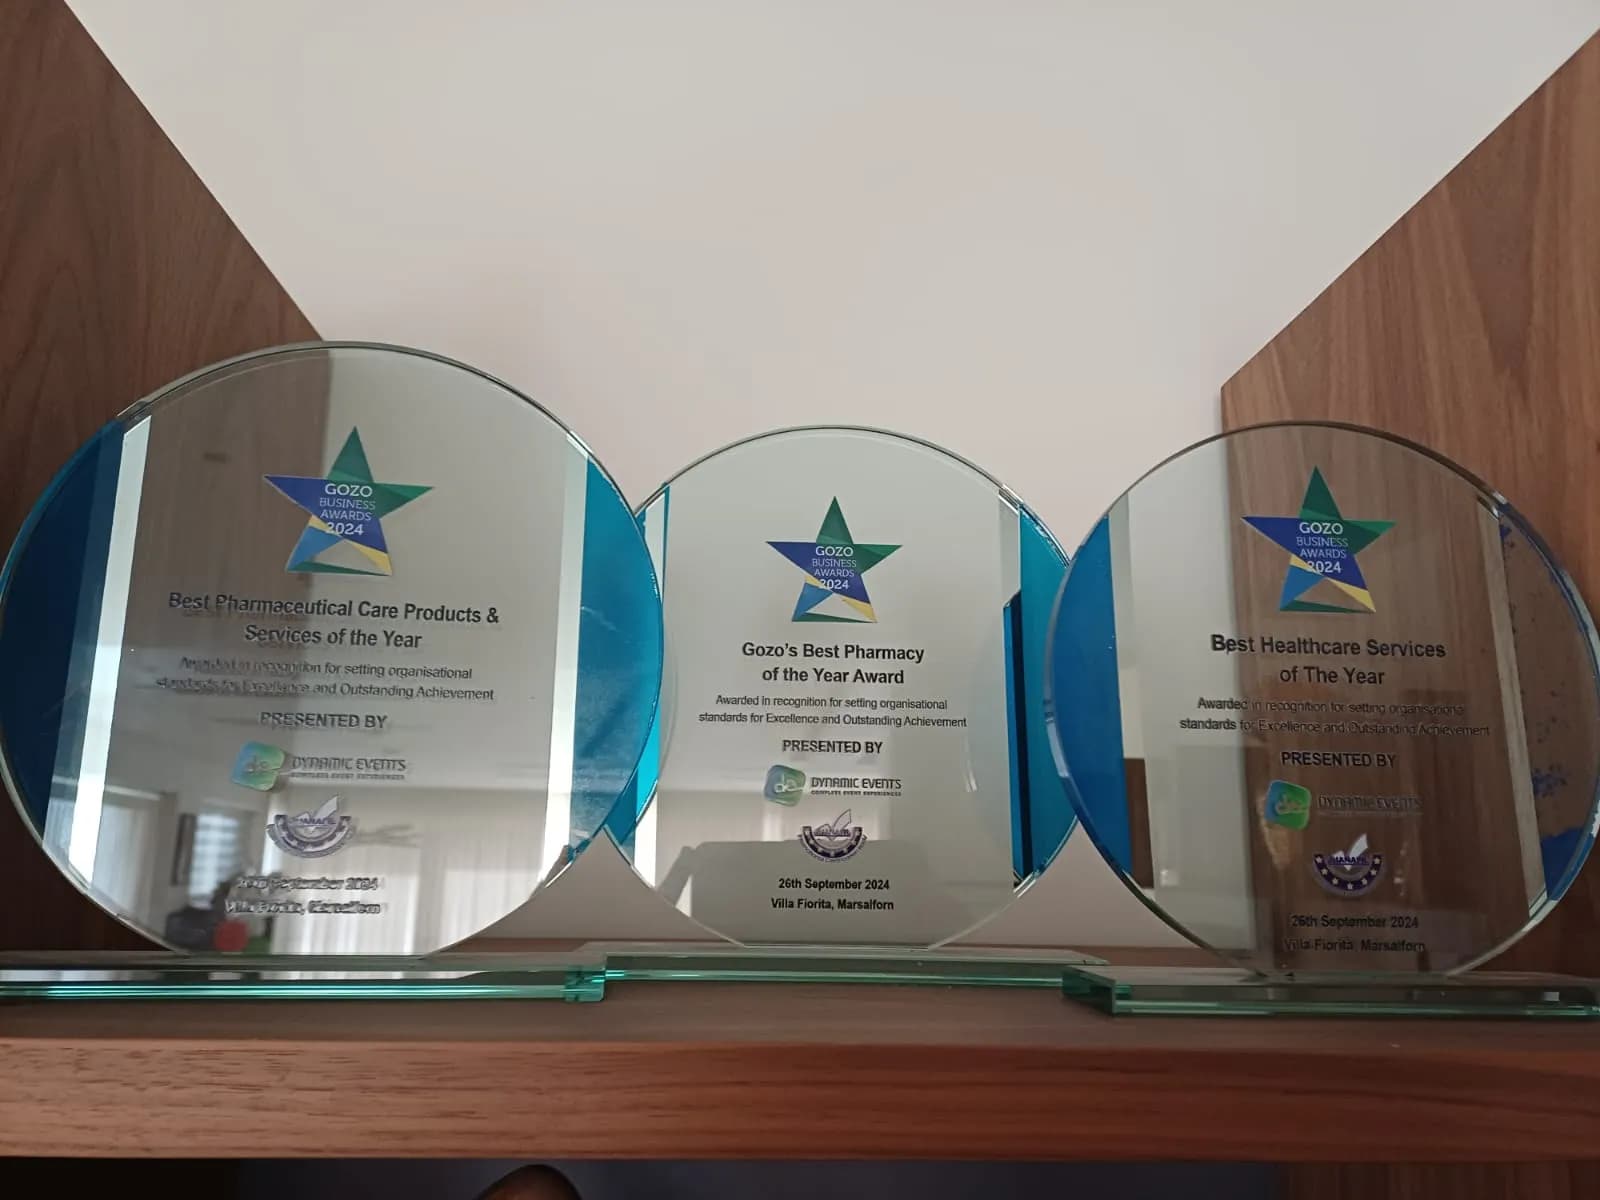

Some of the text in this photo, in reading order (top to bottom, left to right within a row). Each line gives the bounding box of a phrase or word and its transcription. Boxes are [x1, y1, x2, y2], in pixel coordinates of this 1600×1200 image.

[324, 482, 373, 498] GOZO
[319, 497, 376, 511] BUSINESS
[320, 509, 372, 521] AWARDS
[325, 522, 364, 536] 2024
[1299, 522, 1344, 535] GOZO
[1296, 536, 1349, 548] BUSINESS
[815, 546, 854, 557] GOZO
[1300, 548, 1347, 559] AWARDS
[811, 558, 857, 568] BUSINESS
[1307, 560, 1342, 573] 2024
[813, 569, 855, 577] AWARDS
[819, 579, 849, 590] 2024
[168, 592, 500, 624] Best Pharmaceutical Care Products &
[245, 624, 423, 649] Services of the Year
[1211, 634, 1447, 658] Best Healthcare Services
[803, 644, 840, 658] Best
[844, 644, 925, 664] Pharmacy
[325, 662, 341, 674] for
[344, 664, 386, 679] setting
[388, 666, 473, 679] organisational
[762, 667, 904, 684] of the Year Award
[1280, 666, 1385, 685] of The Year
[312, 682, 337, 694] and
[340, 683, 414, 699] Outstanding
[415, 686, 494, 700] Achievement
[716, 695, 948, 711] Awarded in recognition for setting organisational
[1252, 700, 1262, 711] in
[1265, 701, 1328, 714] recognition
[1331, 702, 1347, 713] for
[1349, 702, 1386, 715] setting
[1389, 704, 1466, 717] organisationa
[261, 711, 388, 729] PRESENTED BY
[698, 713, 967, 728] standards for Excellence and Outstanding Achievement
[1179, 718, 1237, 731] standards
[1258, 719, 1321, 732] Excellence
[1324, 721, 1345, 733] and
[1418, 723, 1491, 737] Achievement
[783, 740, 883, 754] PRESENTED BY
[292, 756, 406, 771] DYNAMIC EVENTS
[1281, 751, 1397, 768] PRESENTED BY
[811, 777, 902, 790] DYNAMIC EVENTS
[778, 878, 890, 891] 26th September 2024
[770, 898, 894, 911] Villa Fiorita, Marsalforn
[1290, 913, 1419, 929] 26th September 2024
[1360, 939, 1425, 953] Marsalforn
